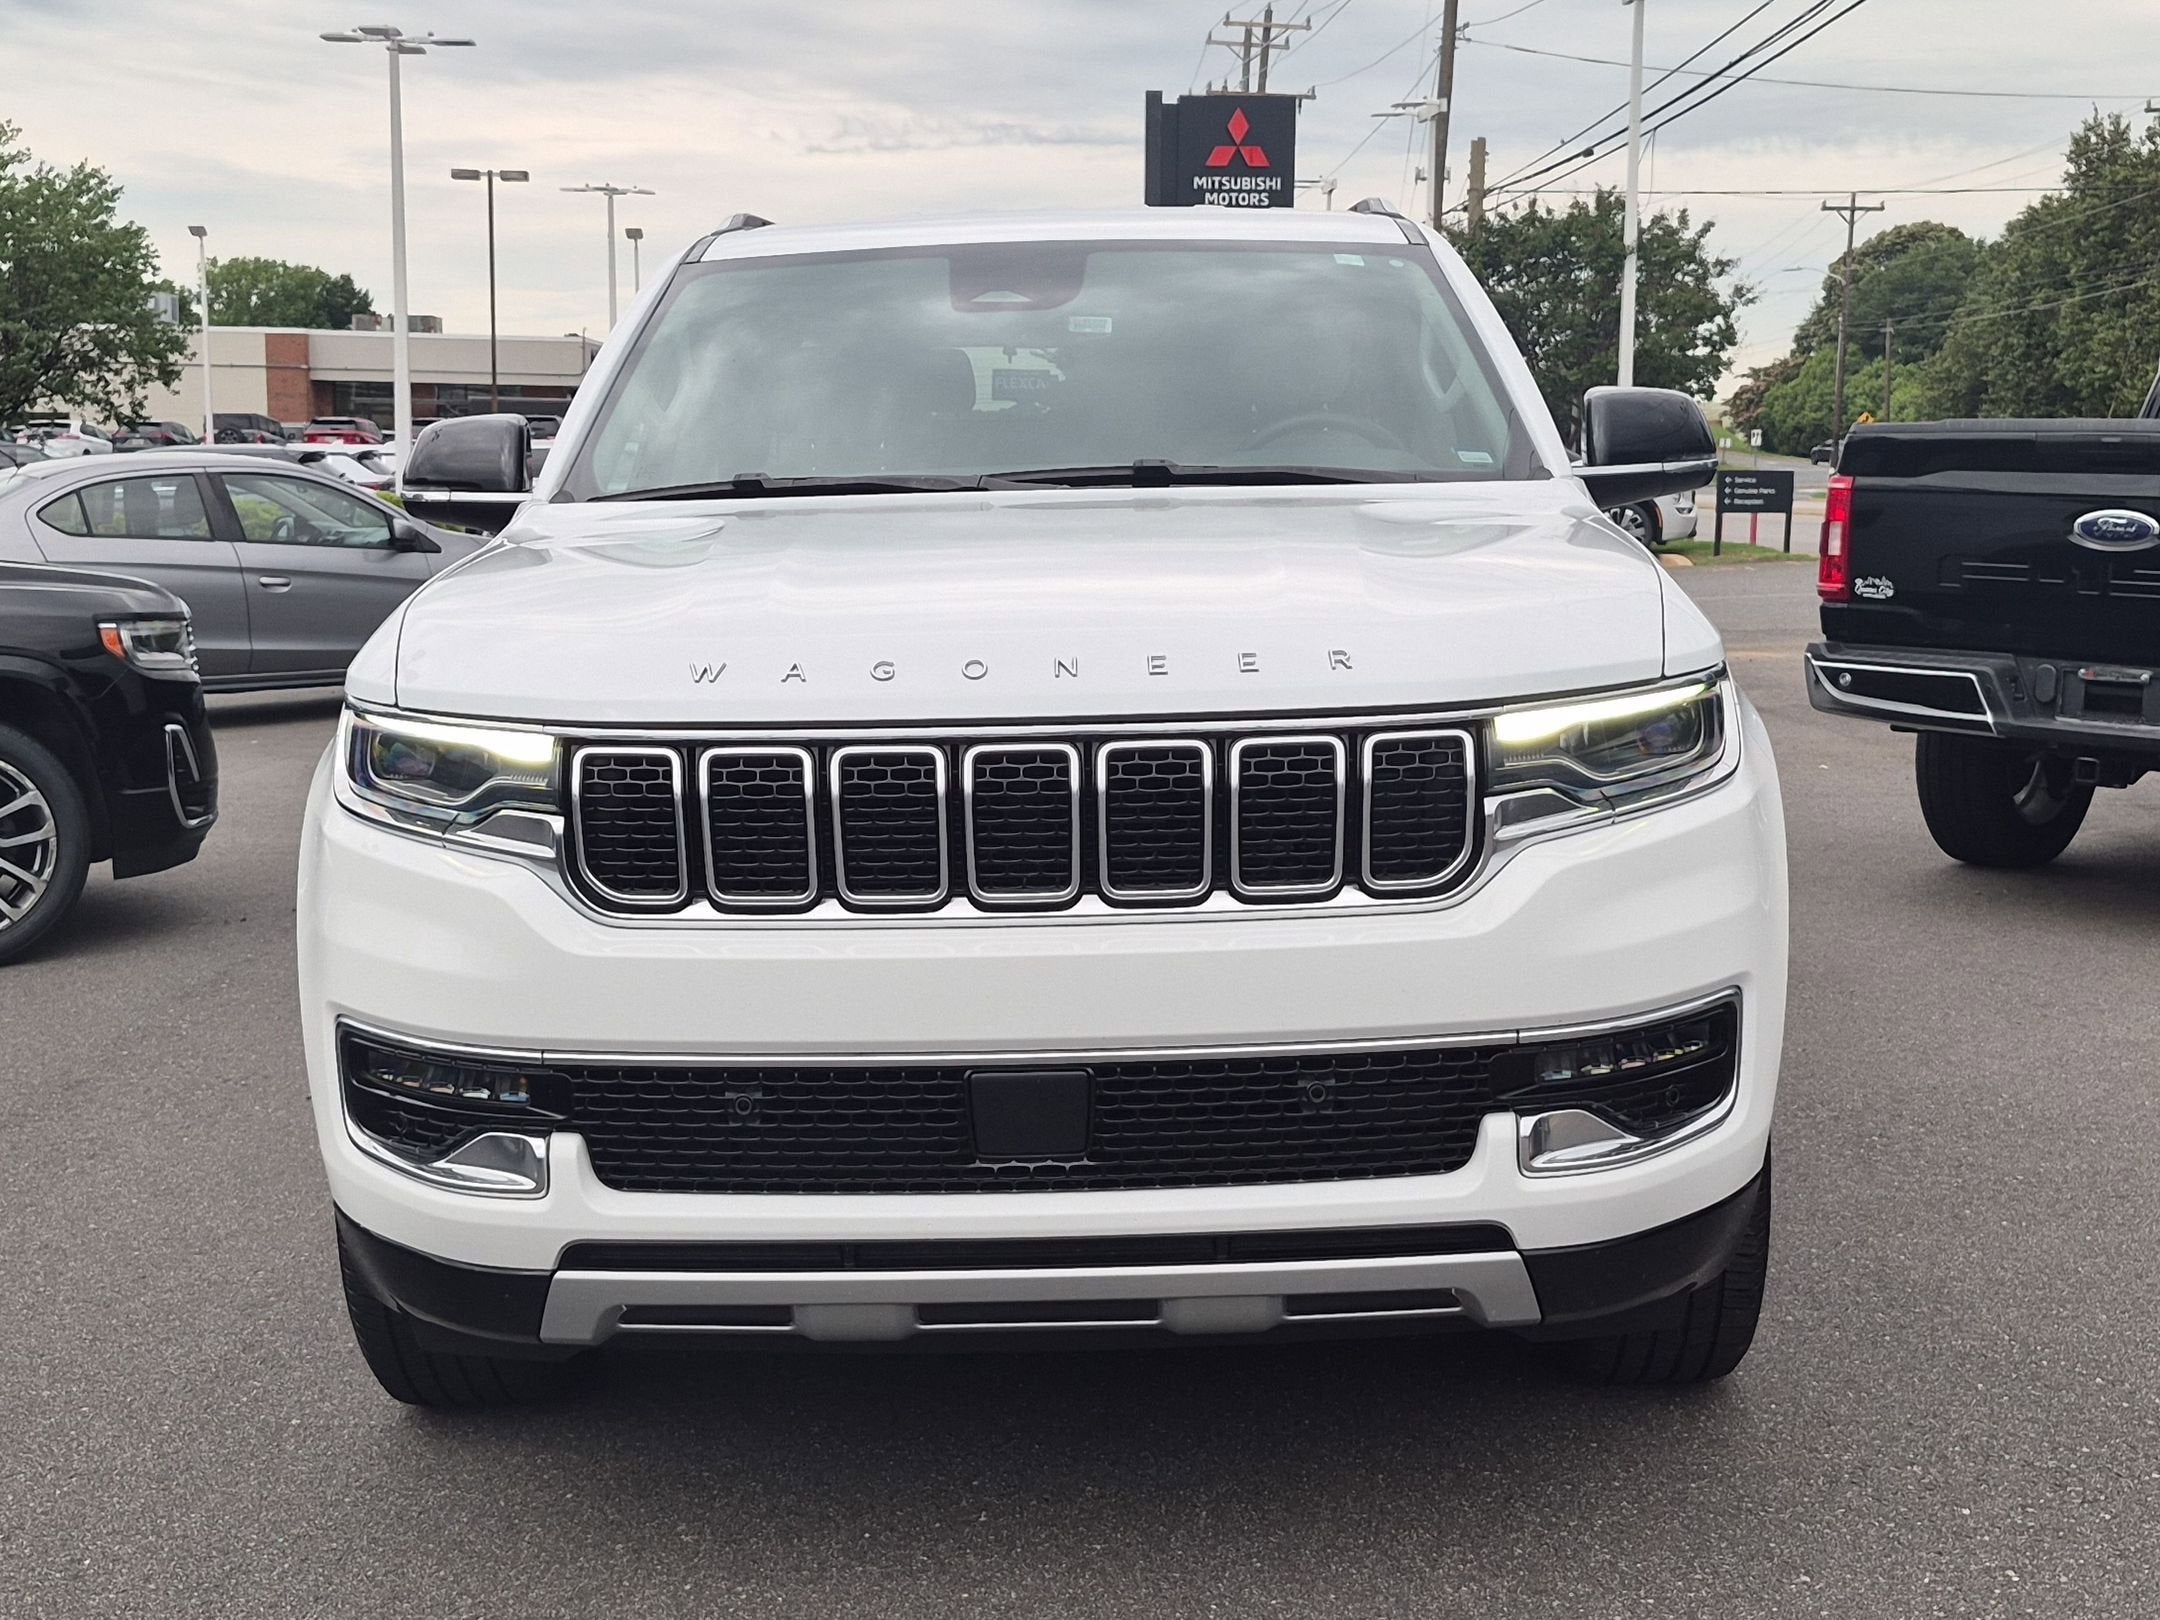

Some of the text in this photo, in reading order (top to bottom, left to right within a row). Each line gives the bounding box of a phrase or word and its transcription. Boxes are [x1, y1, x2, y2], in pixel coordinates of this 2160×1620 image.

[1193, 176, 1282, 191] MITSUBISHI
[1204, 192, 1270, 206] MOTORS
[2093, 517, 2139, 537] Ford
[689, 648, 1353, 684] WAGONEER
